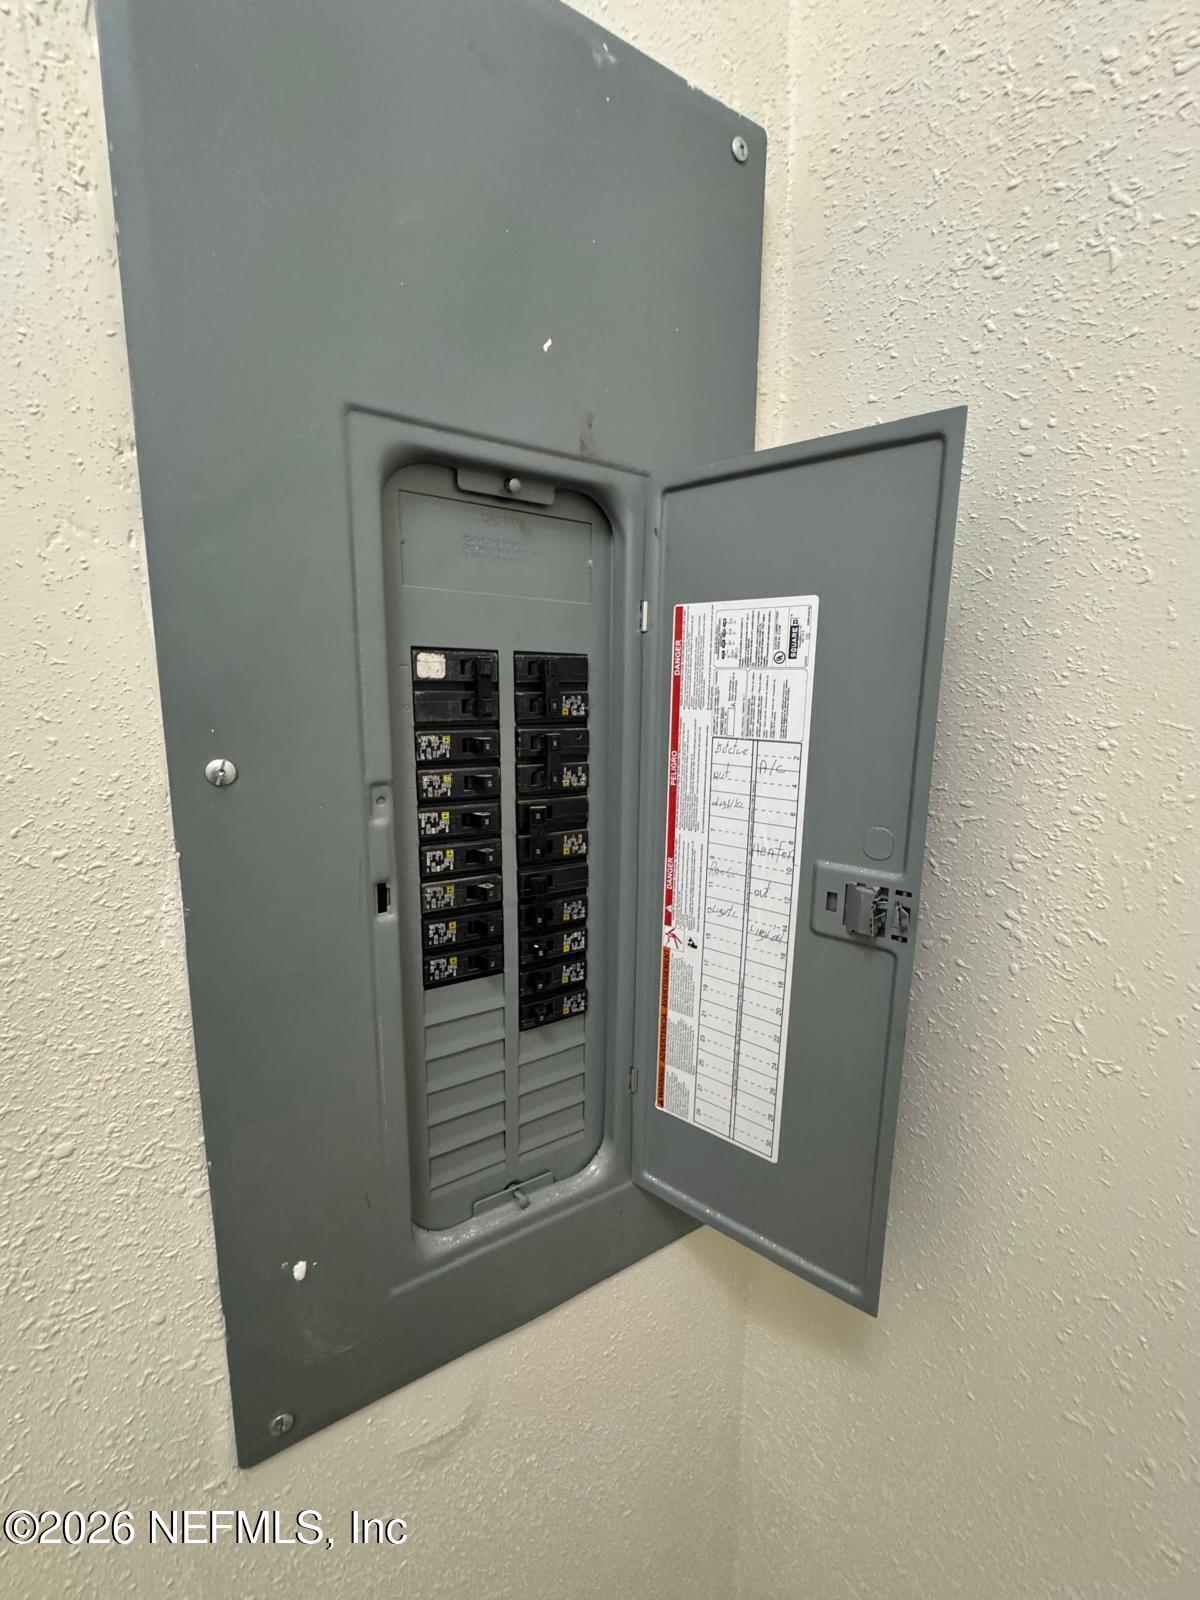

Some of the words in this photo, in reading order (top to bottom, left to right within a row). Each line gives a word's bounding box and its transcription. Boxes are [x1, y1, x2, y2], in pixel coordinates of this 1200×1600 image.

[674, 639, 682, 676] DANGER
[789, 626, 798, 658] SQUARE
[670, 750, 678, 786] PELIGRO
[666, 856, 674, 890] DANGER
[661, 948, 670, 1008] AVERTISSEMENT
